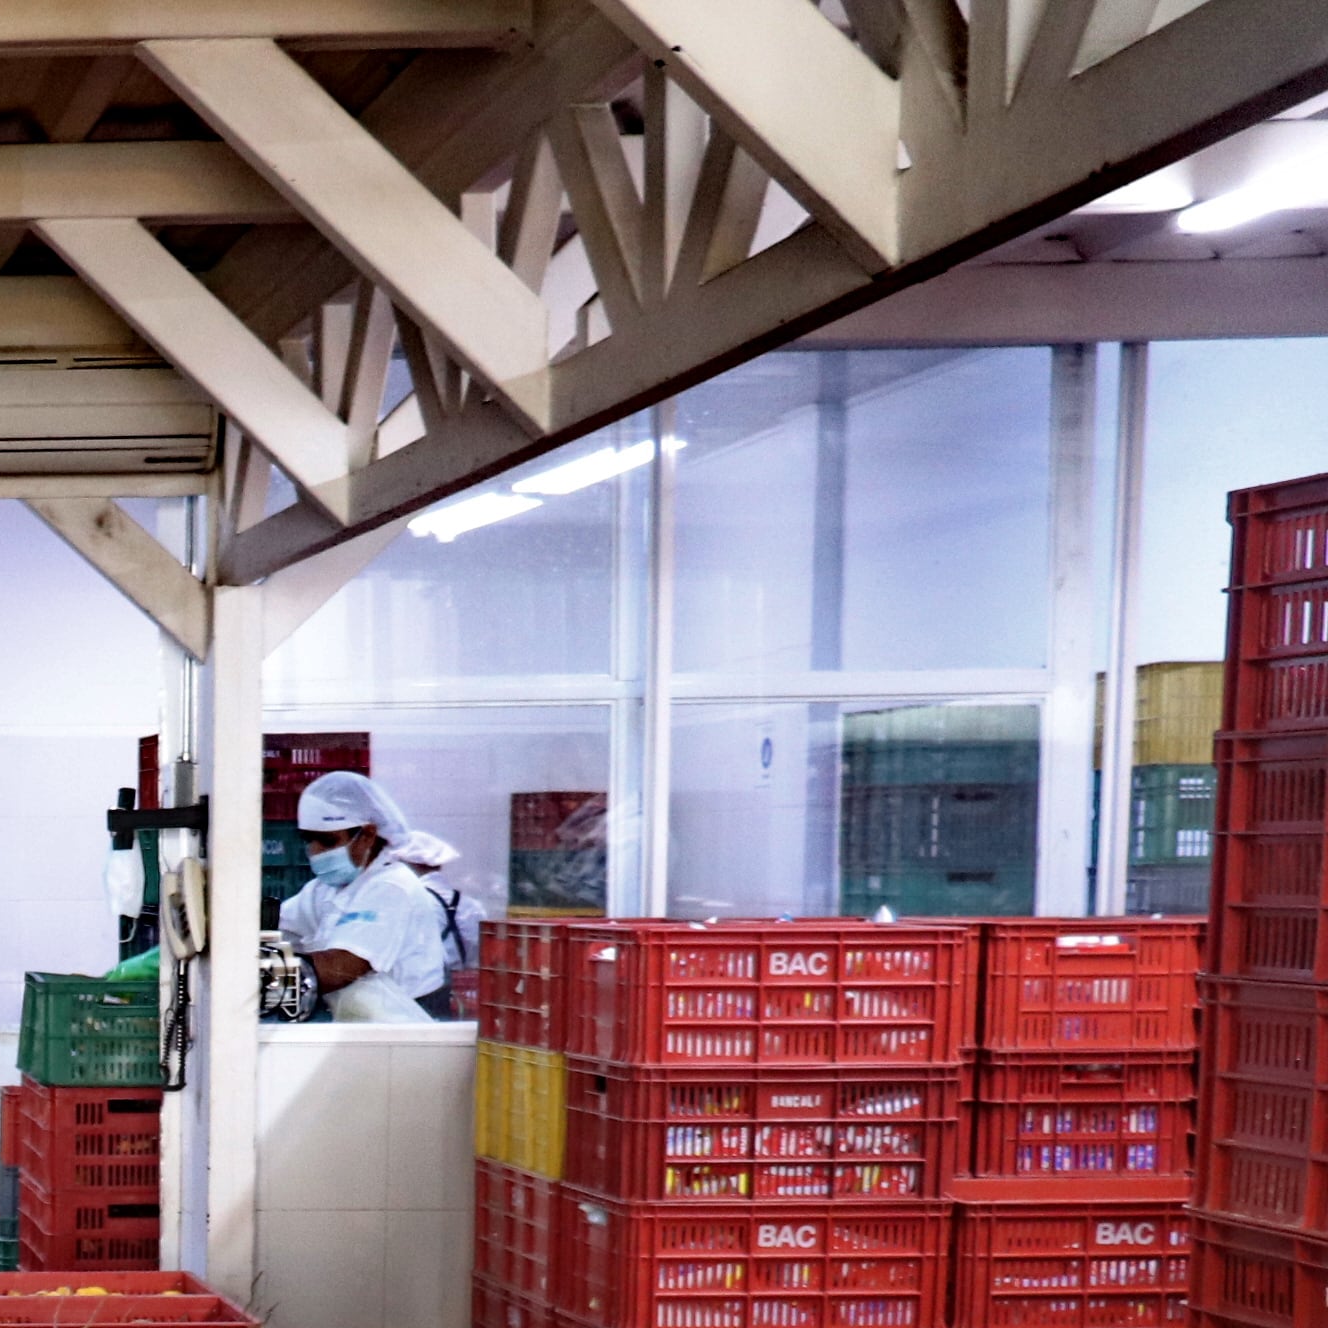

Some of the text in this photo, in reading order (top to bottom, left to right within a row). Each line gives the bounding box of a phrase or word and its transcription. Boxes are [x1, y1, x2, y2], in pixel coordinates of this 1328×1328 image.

[769, 952, 829, 976] BAC
[757, 1225, 817, 1249] BAC
[1096, 1222, 1155, 1246] BAC
